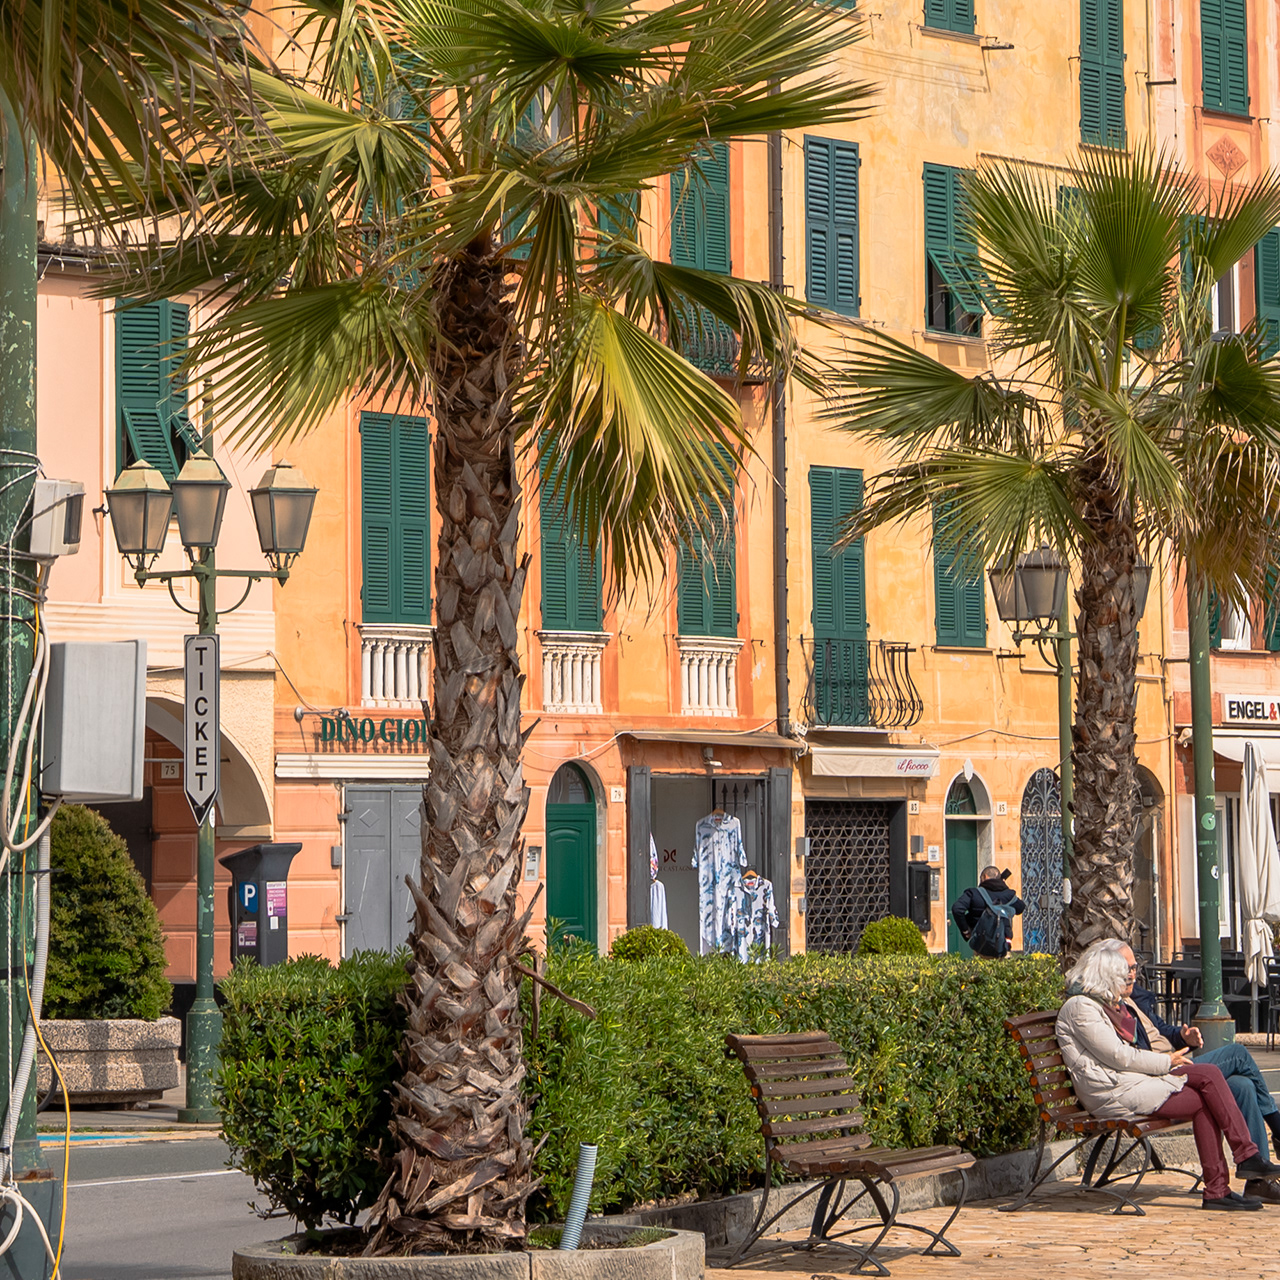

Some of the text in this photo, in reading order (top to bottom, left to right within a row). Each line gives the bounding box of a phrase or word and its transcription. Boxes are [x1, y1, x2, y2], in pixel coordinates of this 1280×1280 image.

[194, 646, 209, 792] TICKET
[320, 717, 429, 743] DINO GIOI
[165, 765, 176, 775] 75
[904, 759, 929, 773] fiocco
[614, 790, 622, 800] 79
[244, 884, 256, 907] P
